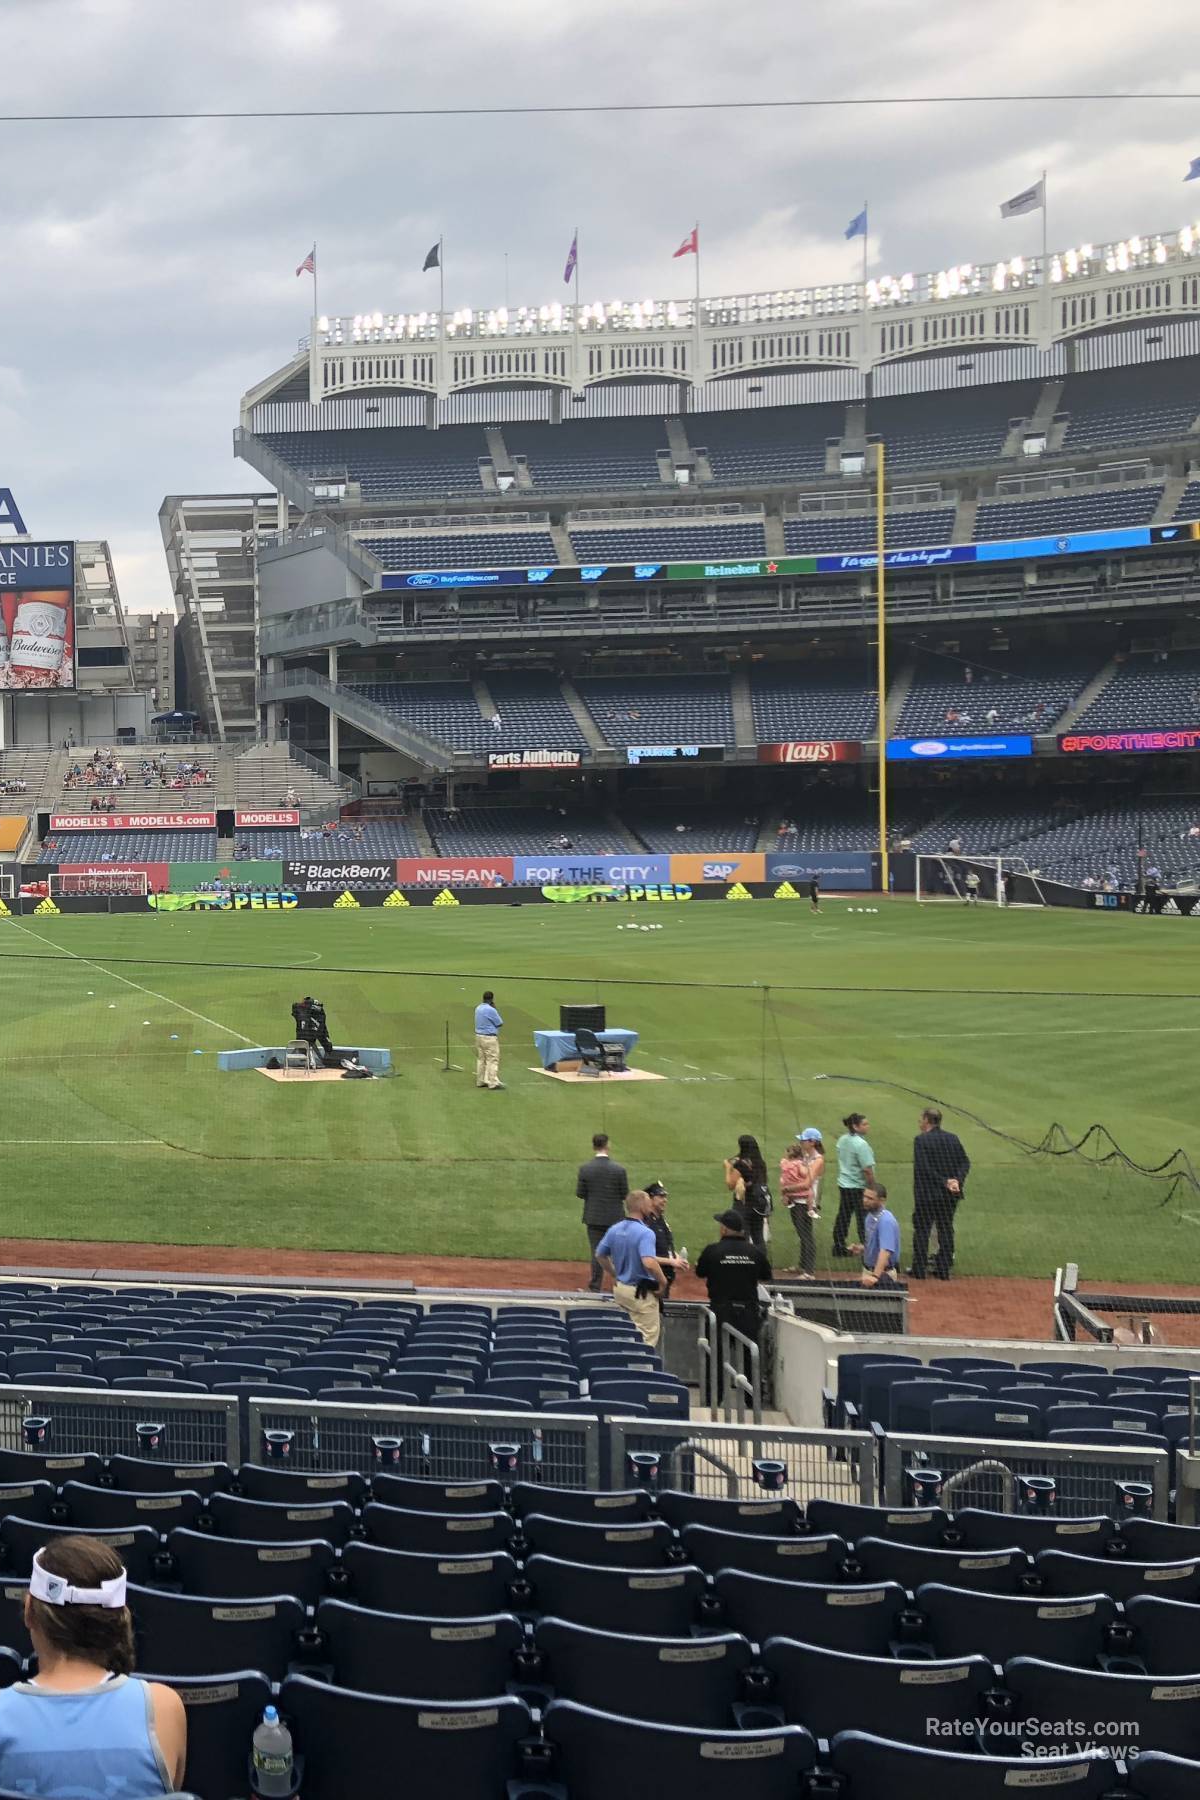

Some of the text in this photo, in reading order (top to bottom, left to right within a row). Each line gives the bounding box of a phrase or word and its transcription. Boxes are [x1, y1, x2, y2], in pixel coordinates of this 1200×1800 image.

[635, 569, 655, 578] SAP
[704, 564, 760, 576] Heineken
[528, 572, 548, 581] SAP
[581, 571, 601, 580] SAP
[489, 750, 580, 764] Parts Authority
[55, 817, 108, 827] MODELL'S
[129, 816, 210, 826] MODELLS.com
[241, 814, 293, 823] MODELL'S
[307, 866, 388, 880] BlackBerry
[417, 870, 495, 881] NISSAN
[568, 867, 604, 879] THE
[609, 866, 649, 879] CITY
[704, 865, 732, 878] SAP
